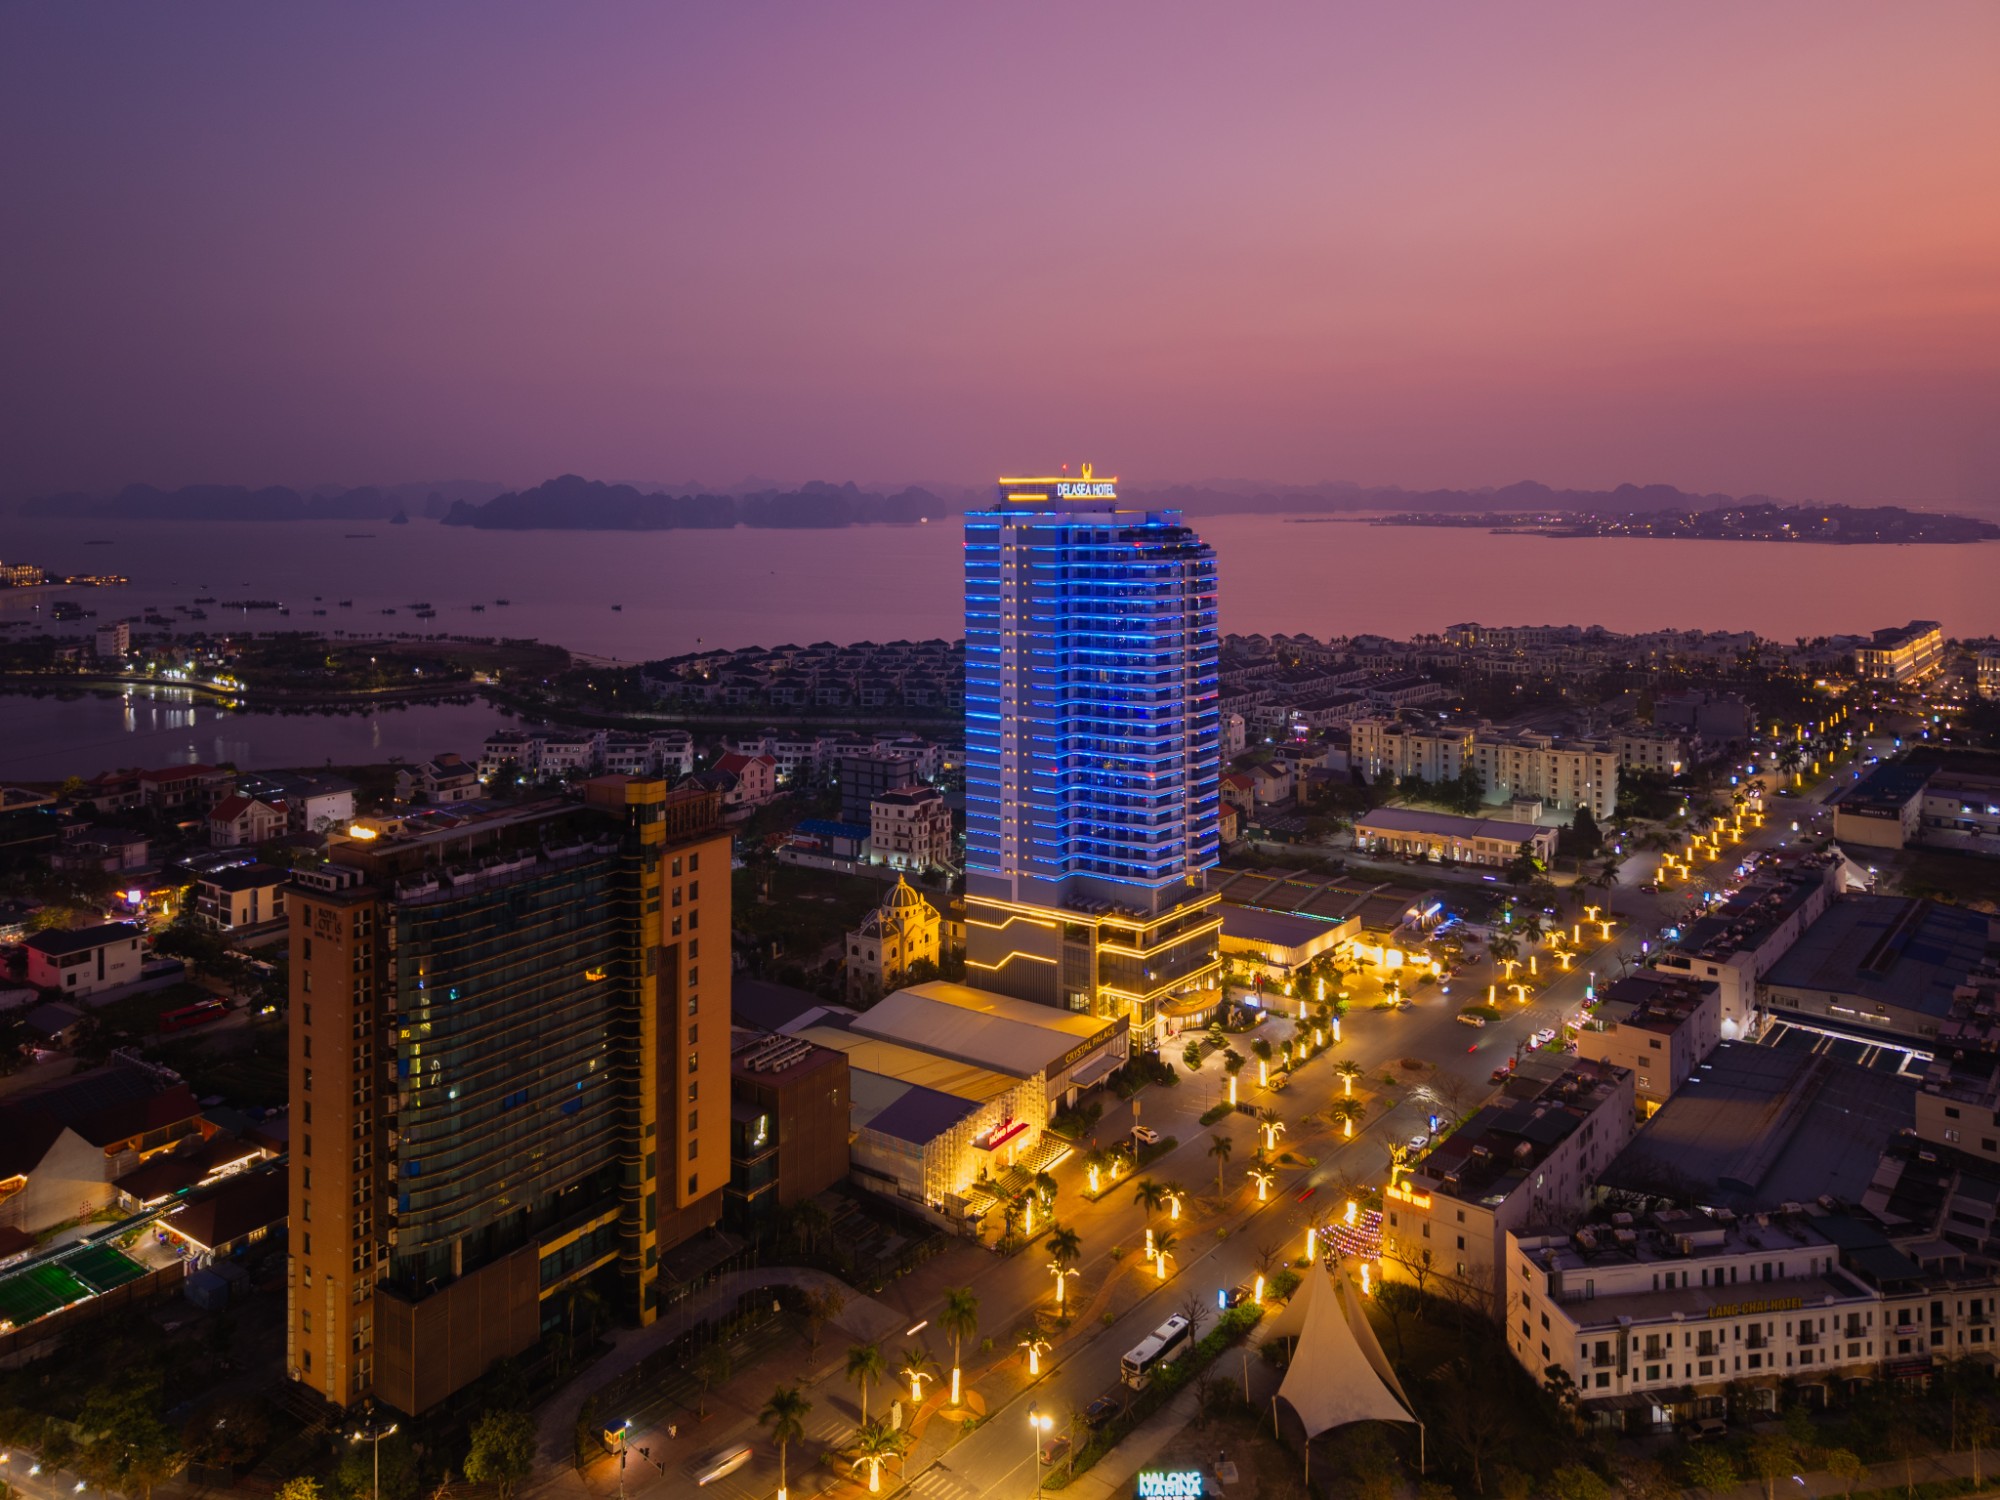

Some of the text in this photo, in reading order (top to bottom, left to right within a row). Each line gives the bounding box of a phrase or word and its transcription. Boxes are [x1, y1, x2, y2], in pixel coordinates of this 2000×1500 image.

[1057, 483, 1115, 496] DELASEA HOTEL
[1065, 1025, 1116, 1064] CRYSTAL PALACE
[1769, 1297, 1803, 1311] HOTEL
[1139, 1471, 1201, 1483] HALONG
[1139, 1481, 1202, 1496] MARINA
